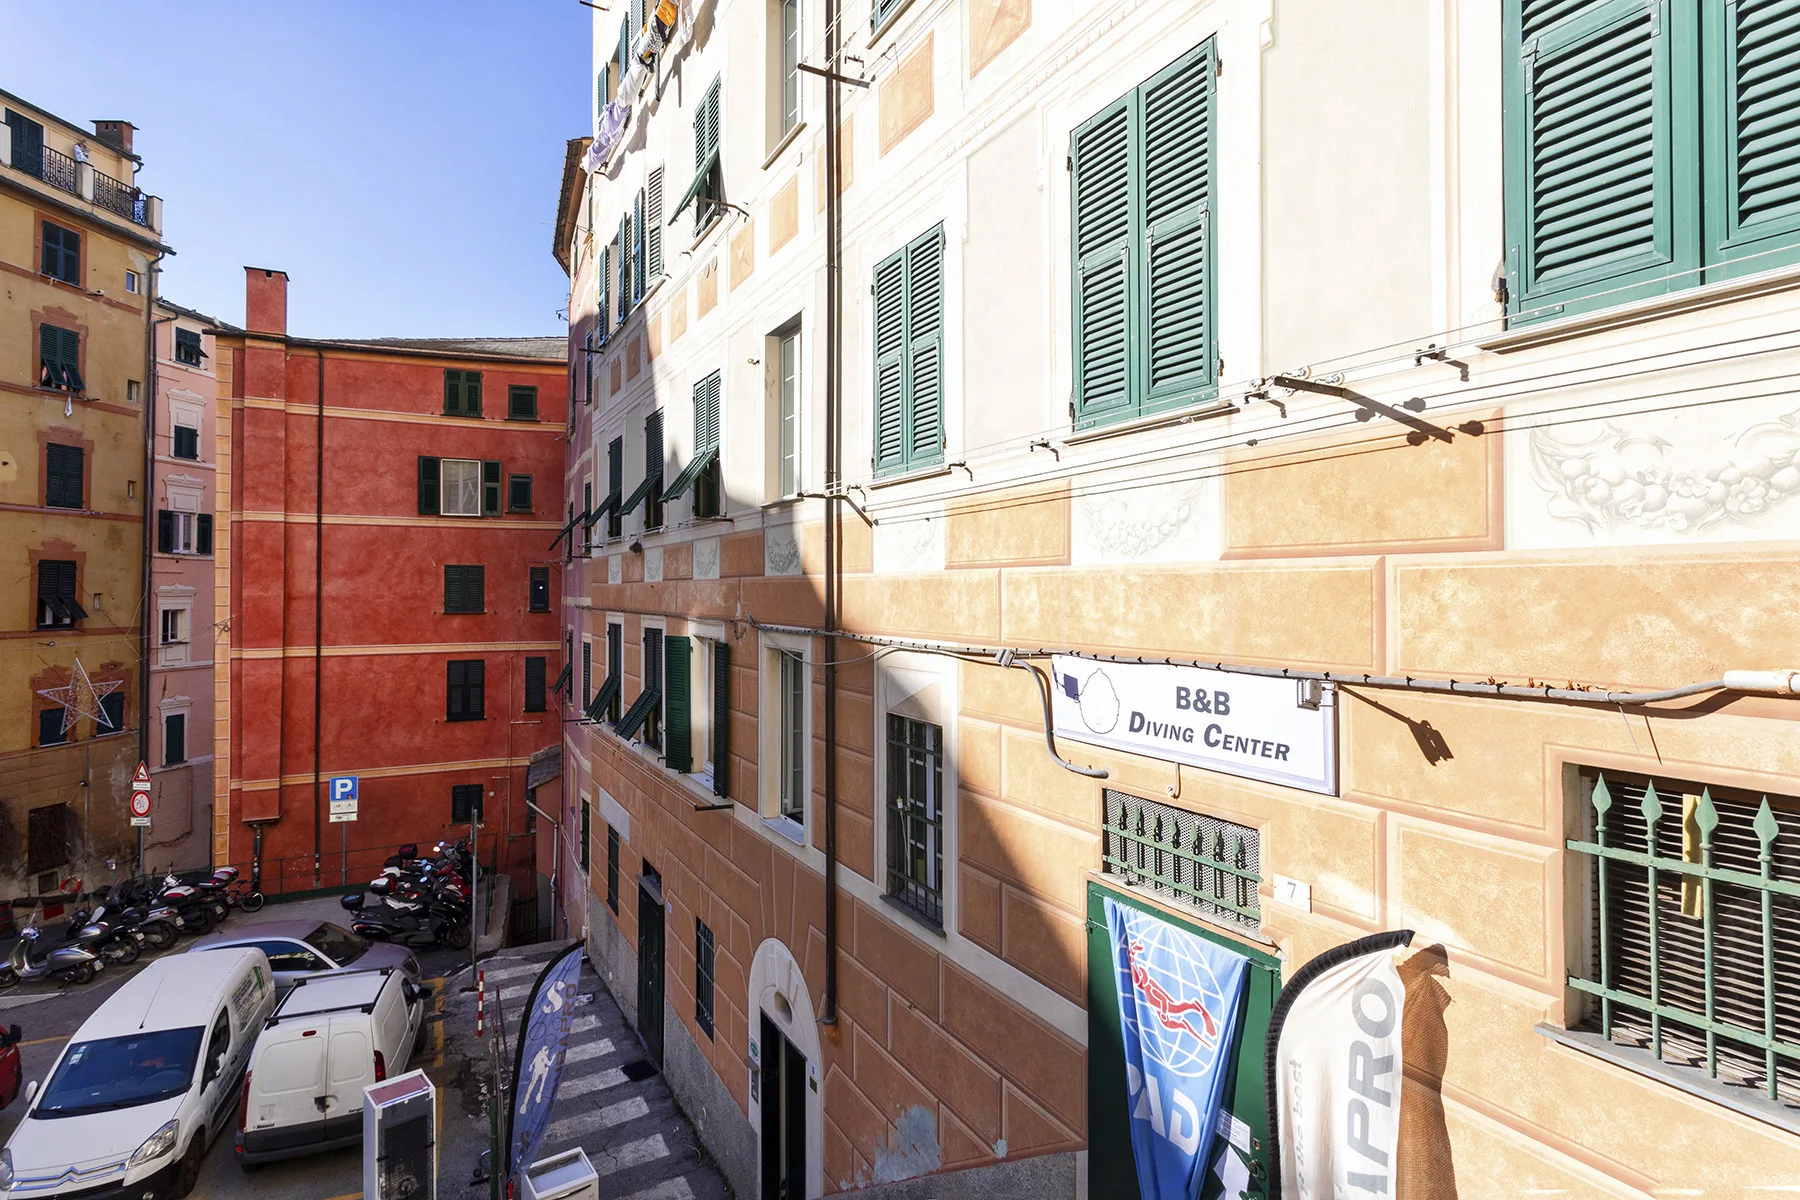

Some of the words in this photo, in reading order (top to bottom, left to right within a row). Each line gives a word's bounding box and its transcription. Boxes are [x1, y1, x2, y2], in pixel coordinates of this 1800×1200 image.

[1176, 686, 1231, 716] B&B
[1128, 710, 1195, 744] DIVING
[1203, 723, 1291, 762] CENTER
[335, 779, 353, 800] P
[1287, 881, 1297, 899] 7
[1289, 1058, 1303, 1118] best
